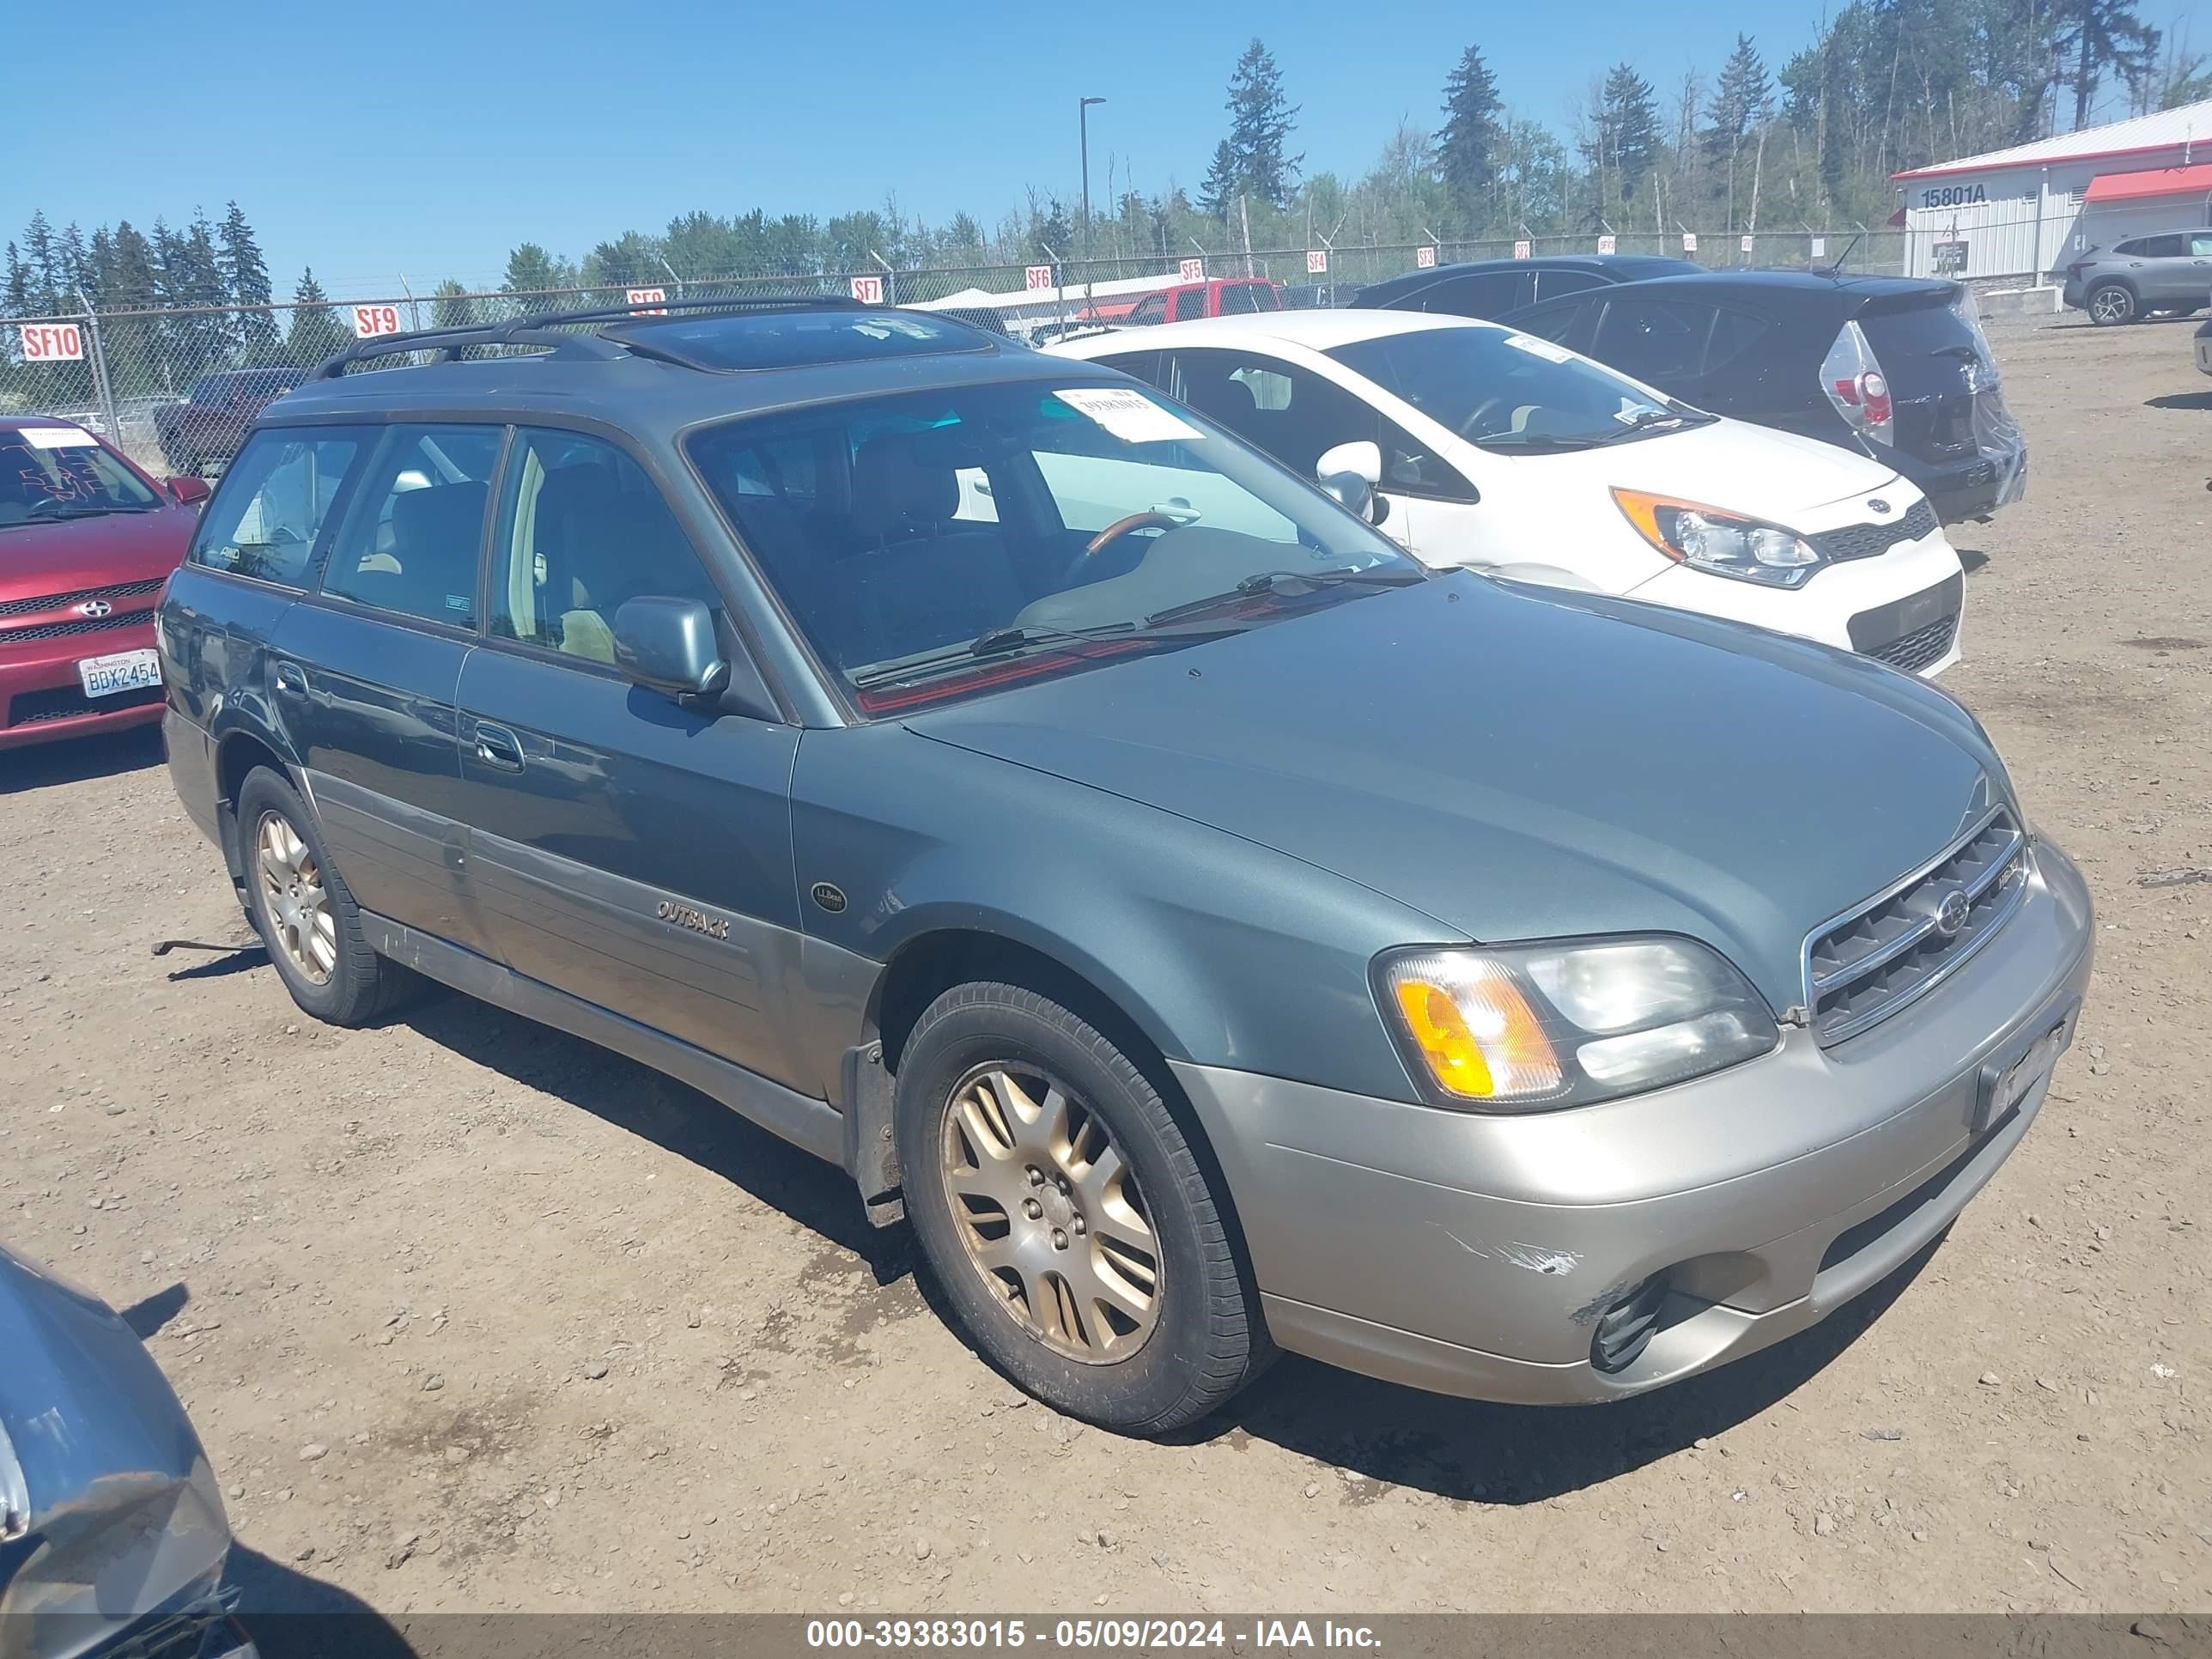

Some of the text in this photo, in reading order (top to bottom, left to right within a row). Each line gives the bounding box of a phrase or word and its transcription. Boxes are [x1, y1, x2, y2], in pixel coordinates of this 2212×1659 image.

[1921, 184, 1986, 209] 15801A
[1309, 253, 1325, 270] SF4
[1419, 249, 1433, 266] SF3
[1028, 269, 1050, 289] SF6
[1182, 260, 1201, 281] SF5
[854, 280, 878, 301] SF7
[356, 307, 397, 334] SF9
[24, 327, 79, 357] SF10
[220, 546, 240, 560] AWD
[86, 658, 131, 671] WASHINGTON
[658, 900, 731, 940] OUTBACK
